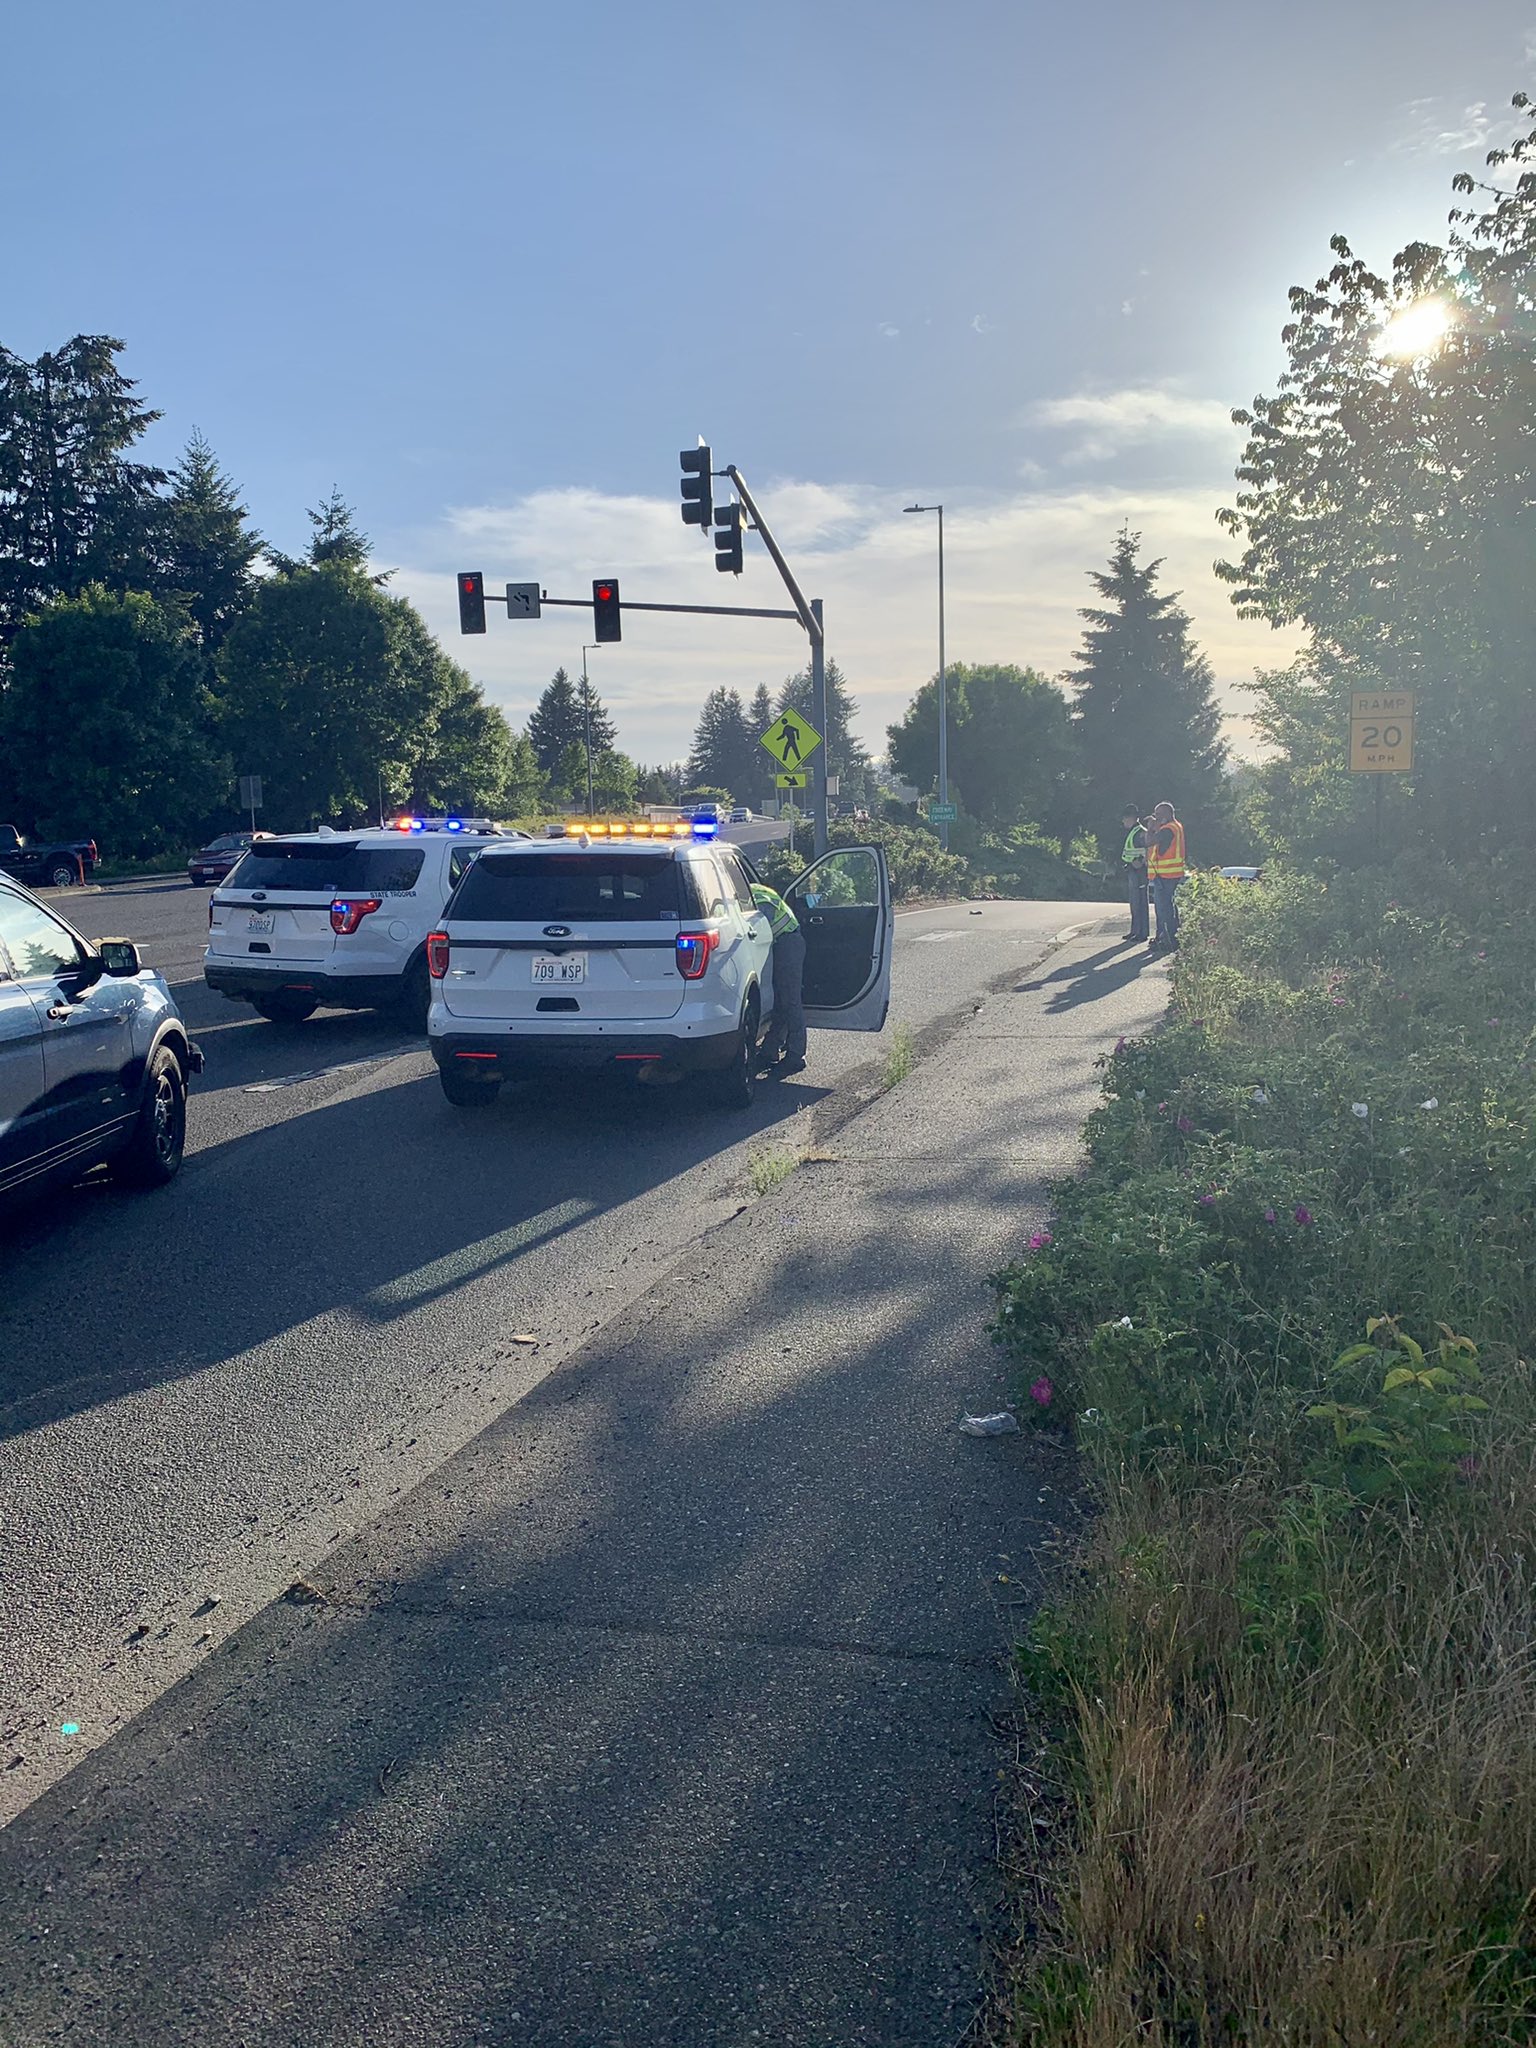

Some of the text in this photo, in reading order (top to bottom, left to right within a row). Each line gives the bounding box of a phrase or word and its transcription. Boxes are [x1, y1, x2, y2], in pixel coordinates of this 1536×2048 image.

[1359, 698, 1406, 711] RAMP
[1361, 726, 1402, 748] 20
[1367, 754, 1395, 763] MPH
[370, 890, 417, 899] STATE TROOPER
[534, 965, 582, 979] 709 WSP
